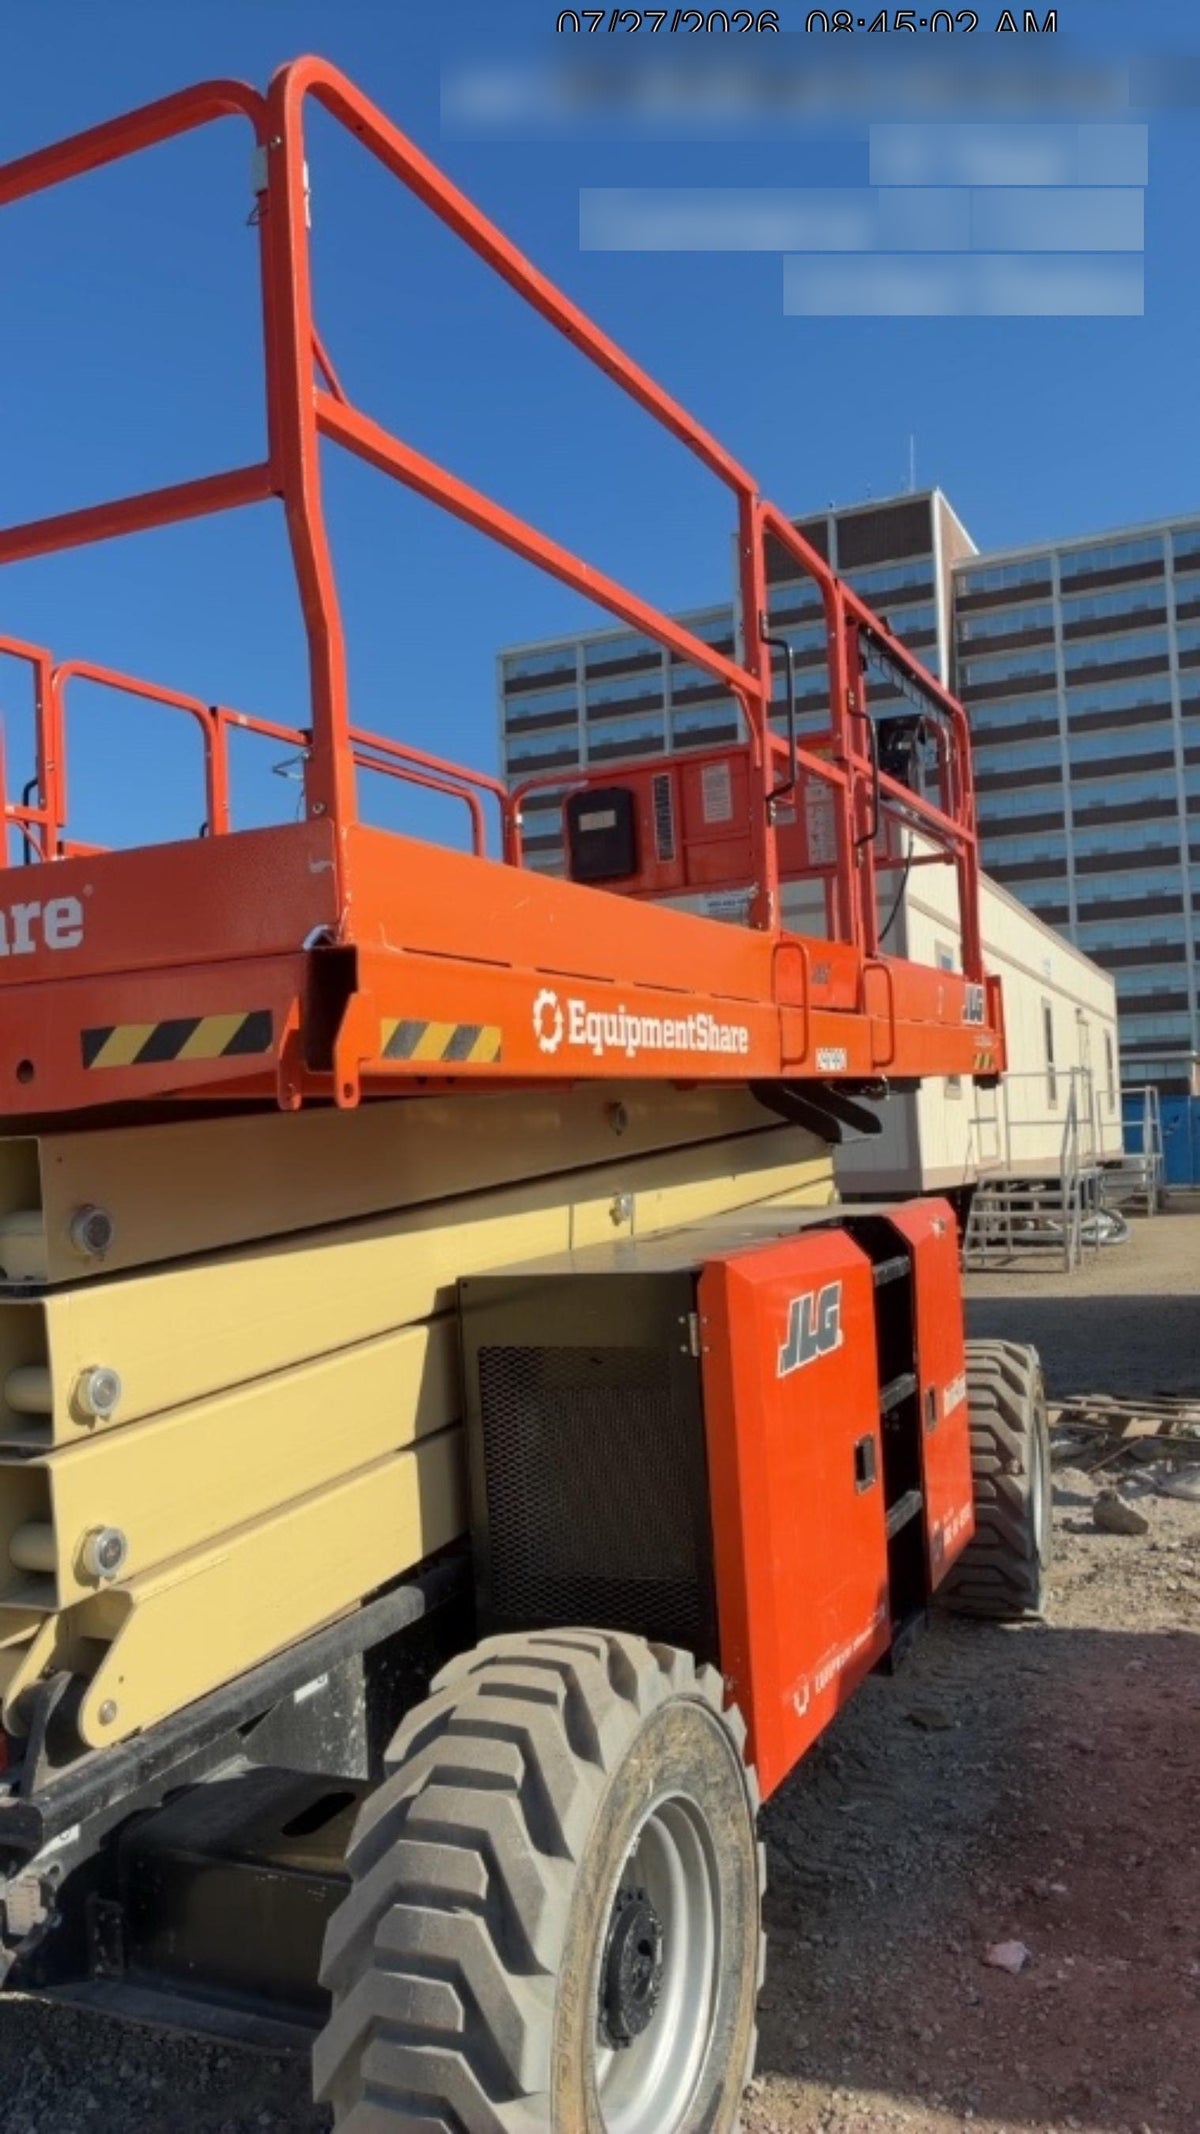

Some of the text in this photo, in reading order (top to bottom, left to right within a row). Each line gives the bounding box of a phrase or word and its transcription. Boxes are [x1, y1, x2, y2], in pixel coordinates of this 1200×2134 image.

[0, 896, 84, 956] re
[567, 997, 749, 1058] EquipmentShare
[777, 1280, 843, 1378] JLG
